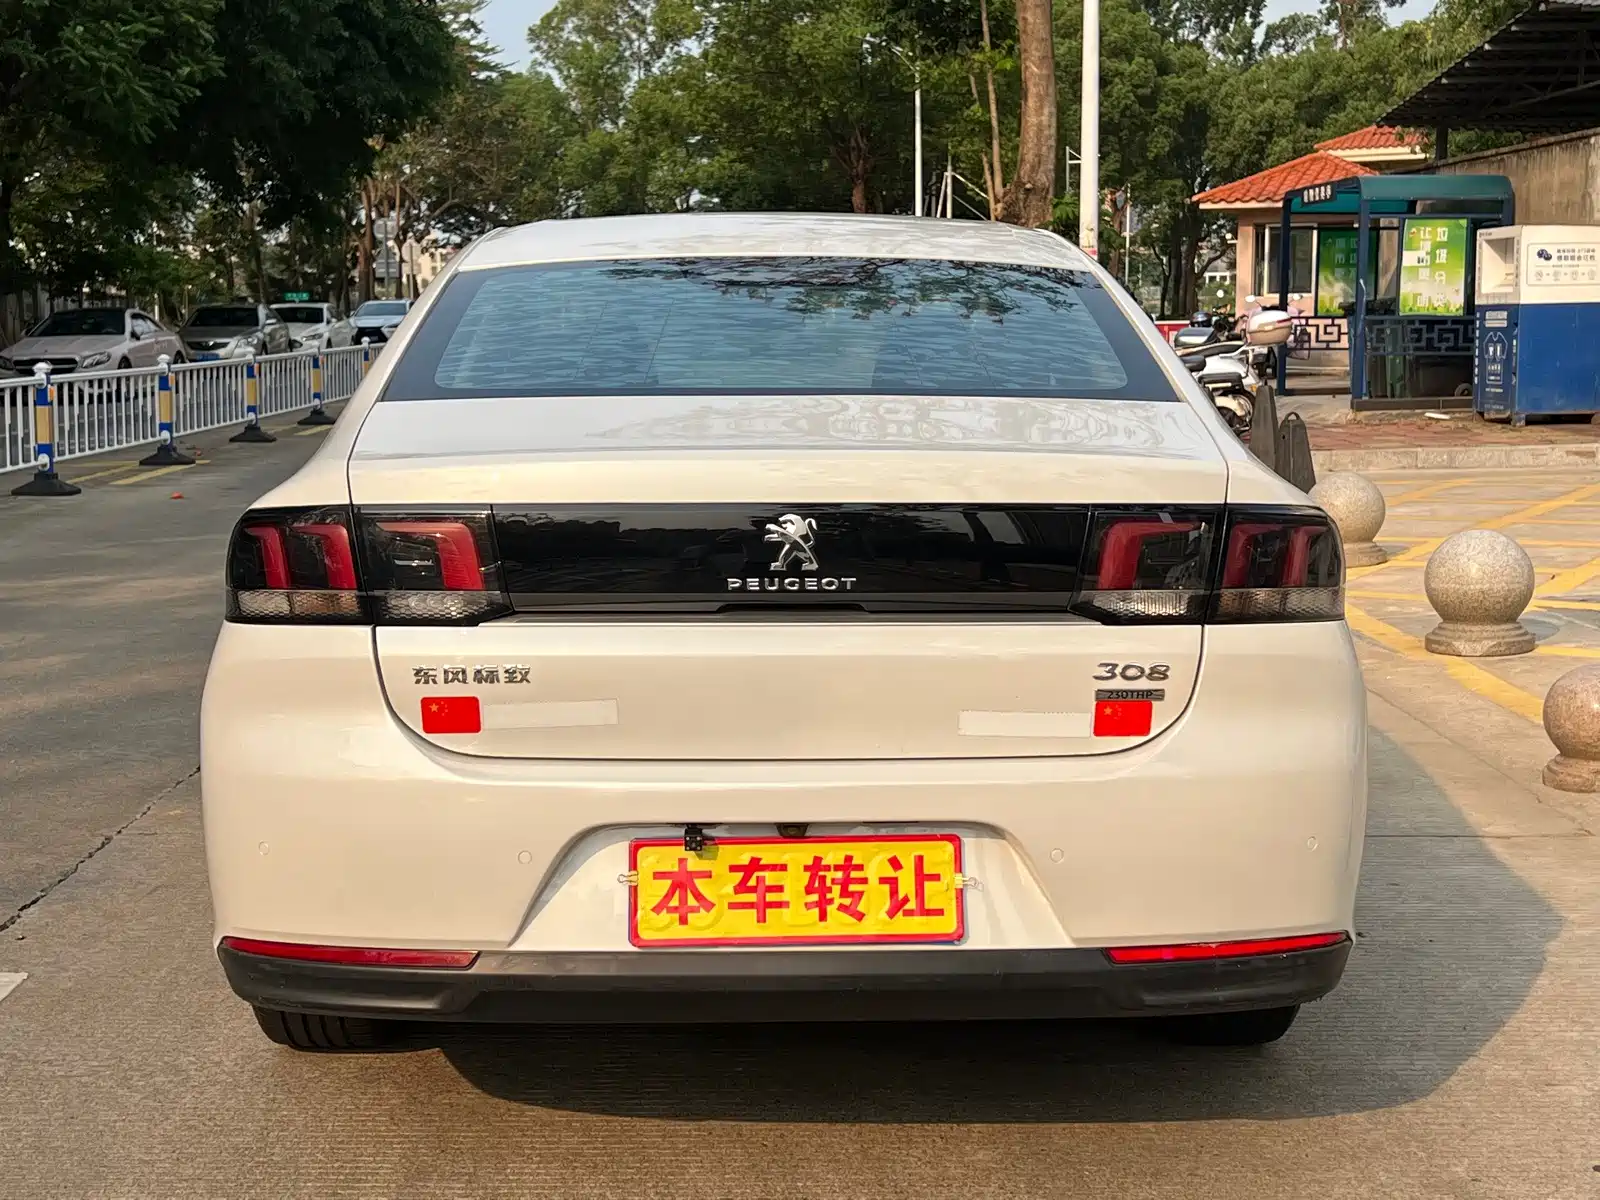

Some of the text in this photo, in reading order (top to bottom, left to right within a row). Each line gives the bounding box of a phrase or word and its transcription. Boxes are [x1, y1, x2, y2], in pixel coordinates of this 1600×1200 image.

[726, 577, 857, 591] PEUGEOT
[412, 664, 531, 685] 东风标致
[1092, 662, 1171, 682] 308
[1107, 690, 1154, 700] 230THP
[651, 854, 945, 926] 本车转让
